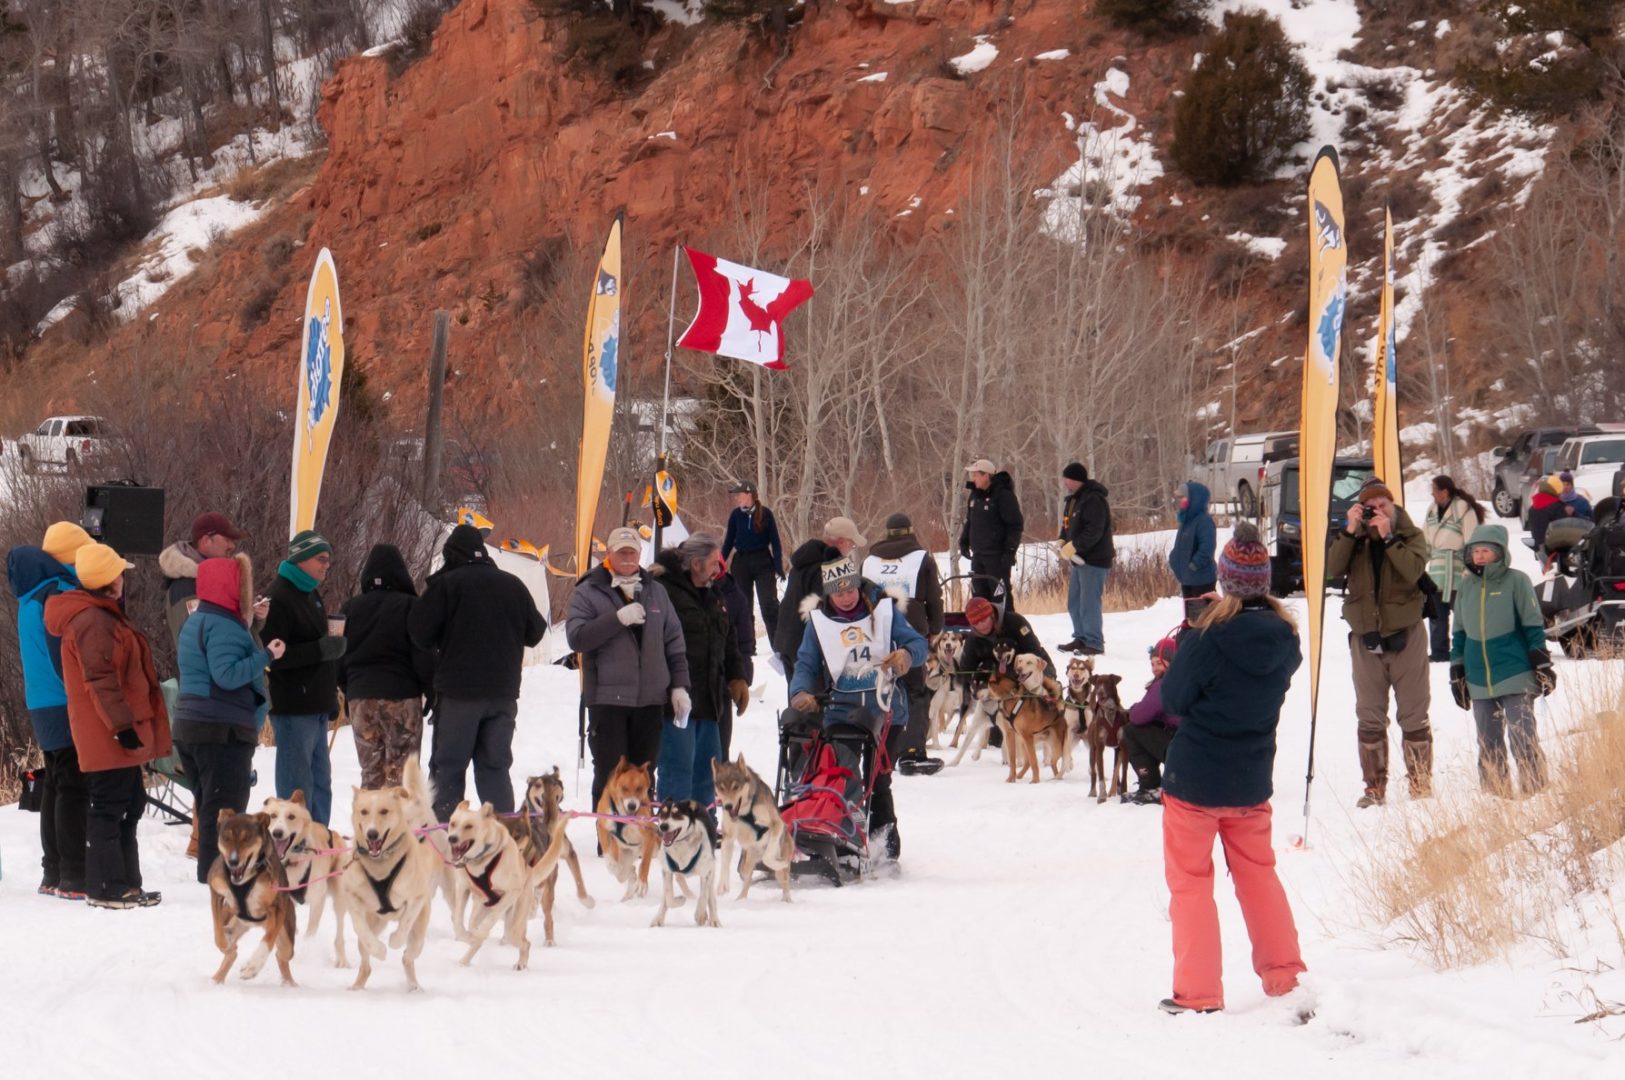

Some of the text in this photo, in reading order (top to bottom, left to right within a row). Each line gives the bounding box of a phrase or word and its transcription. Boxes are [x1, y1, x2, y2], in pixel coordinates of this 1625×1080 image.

[822, 561, 855, 581] RAMS
[880, 564, 898, 575] 22
[850, 646, 871, 662] 14
